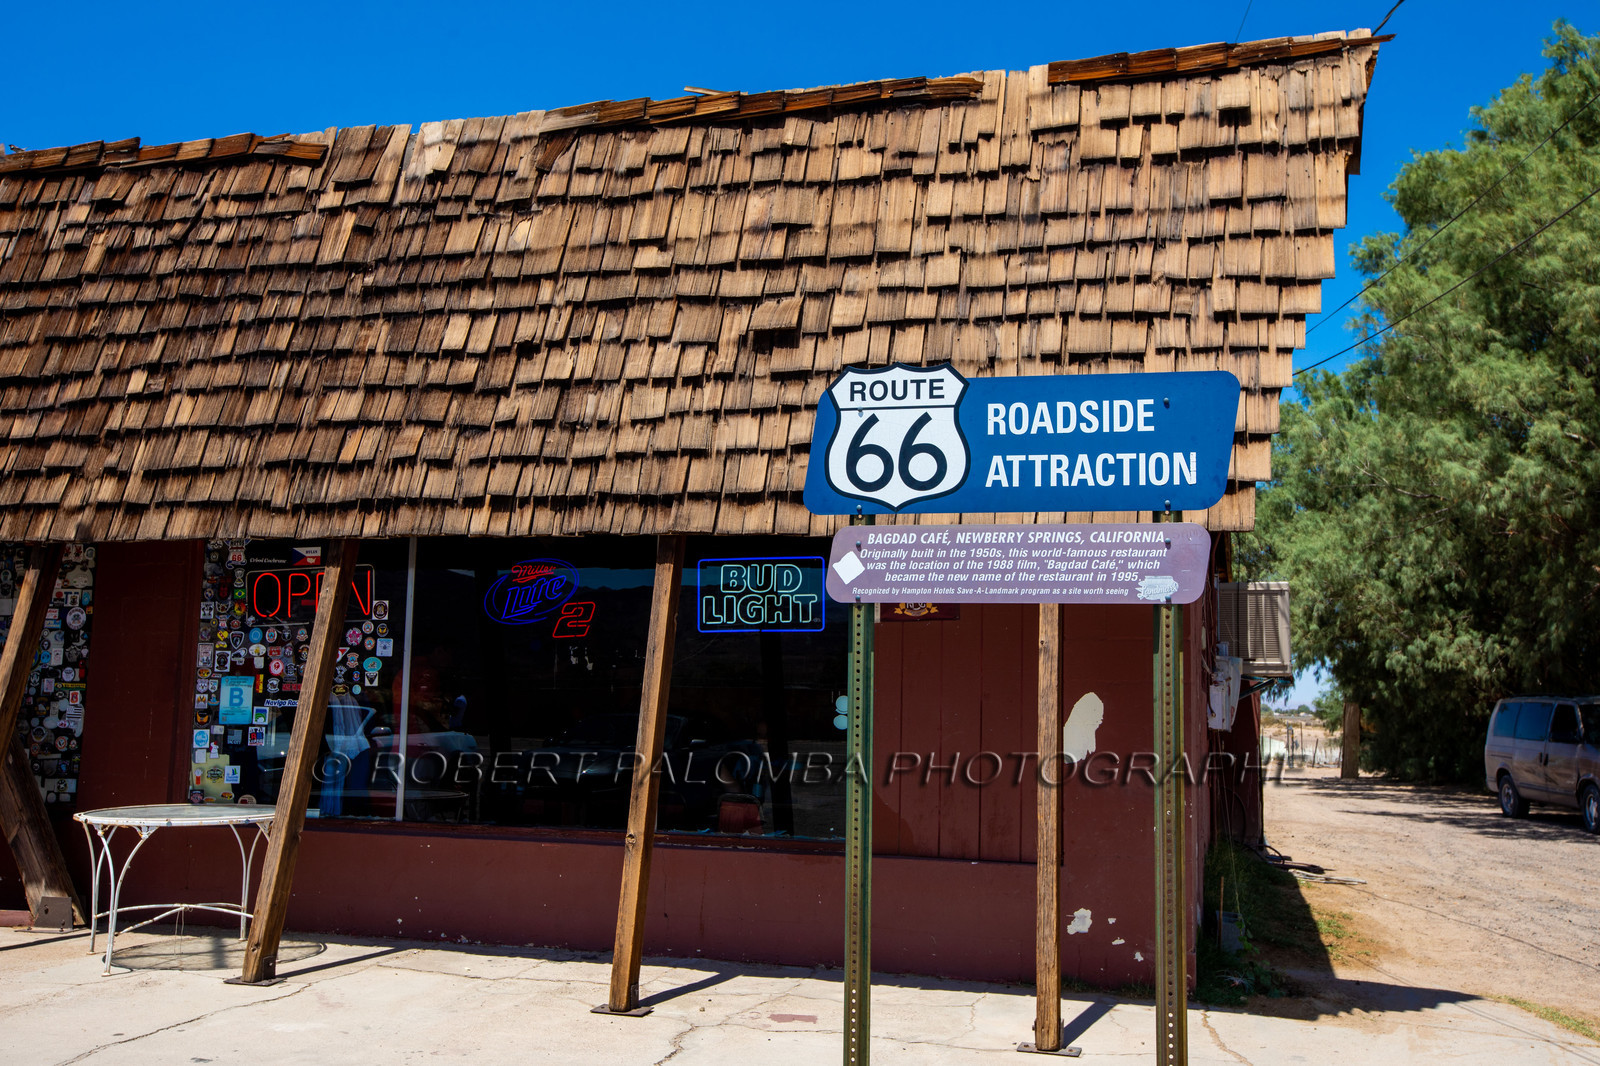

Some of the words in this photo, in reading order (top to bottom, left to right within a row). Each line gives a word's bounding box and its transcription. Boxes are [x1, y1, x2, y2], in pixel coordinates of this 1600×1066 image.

[849, 378, 945, 401] ROUTE
[987, 399, 1155, 436] ROADSIDE
[845, 411, 948, 492] 66
[985, 452, 1198, 488] ATTRACTION
[867, 532, 917, 545] BAGDAD
[920, 530, 951, 546] CAFÉ,
[955, 531, 1024, 545] NEWBERRY
[1027, 531, 1085, 545] SPRINGS,
[1089, 531, 1165, 543] CALIFORNIA
[860, 548, 908, 561] Originally
[911, 548, 934, 558] built
[937, 548, 947, 558] in
[950, 548, 967, 558] the
[970, 548, 1005, 560] 1950s,
[1008, 548, 1028, 558] this
[1031, 547, 1107, 558] world-famous
[1110, 548, 1168, 558] restaurant
[867, 561, 887, 570] was
[889, 560, 906, 570] the
[908, 560, 949, 570] location
[953, 560, 964, 570] of
[967, 560, 983, 570] the
[987, 560, 1013, 570] 1988
[1016, 559, 1040, 571] film,
[1044, 559, 1089, 572] "Bagdad
[1127, 559, 1161, 570] which
[511, 564, 556, 581] Miller
[720, 564, 802, 592] BUD
[885, 572, 925, 582] became
[928, 572, 944, 582] the
[947, 574, 969, 582] new
[972, 573, 1001, 582] name
[1004, 572, 1015, 582] of
[1018, 572, 1035, 582] the
[1038, 572, 1095, 582] restaurant
[1096, 572, 1107, 582] in
[1111, 572, 1142, 582] 1995.
[501, 575, 566, 619] Lite
[852, 587, 890, 596] Recognized
[892, 587, 900, 597] by
[902, 587, 932, 597] Hampton
[933, 587, 955, 595] Hotels
[956, 587, 1019, 595] Save-A-Landmark
[1020, 588, 1050, 597] program
[1069, 587, 1082, 595] site
[1083, 587, 1104, 595] worth
[1105, 587, 1129, 597] seeing
[553, 601, 596, 638] 2
[702, 594, 818, 624] LIGHT
[229, 687, 244, 707] B
